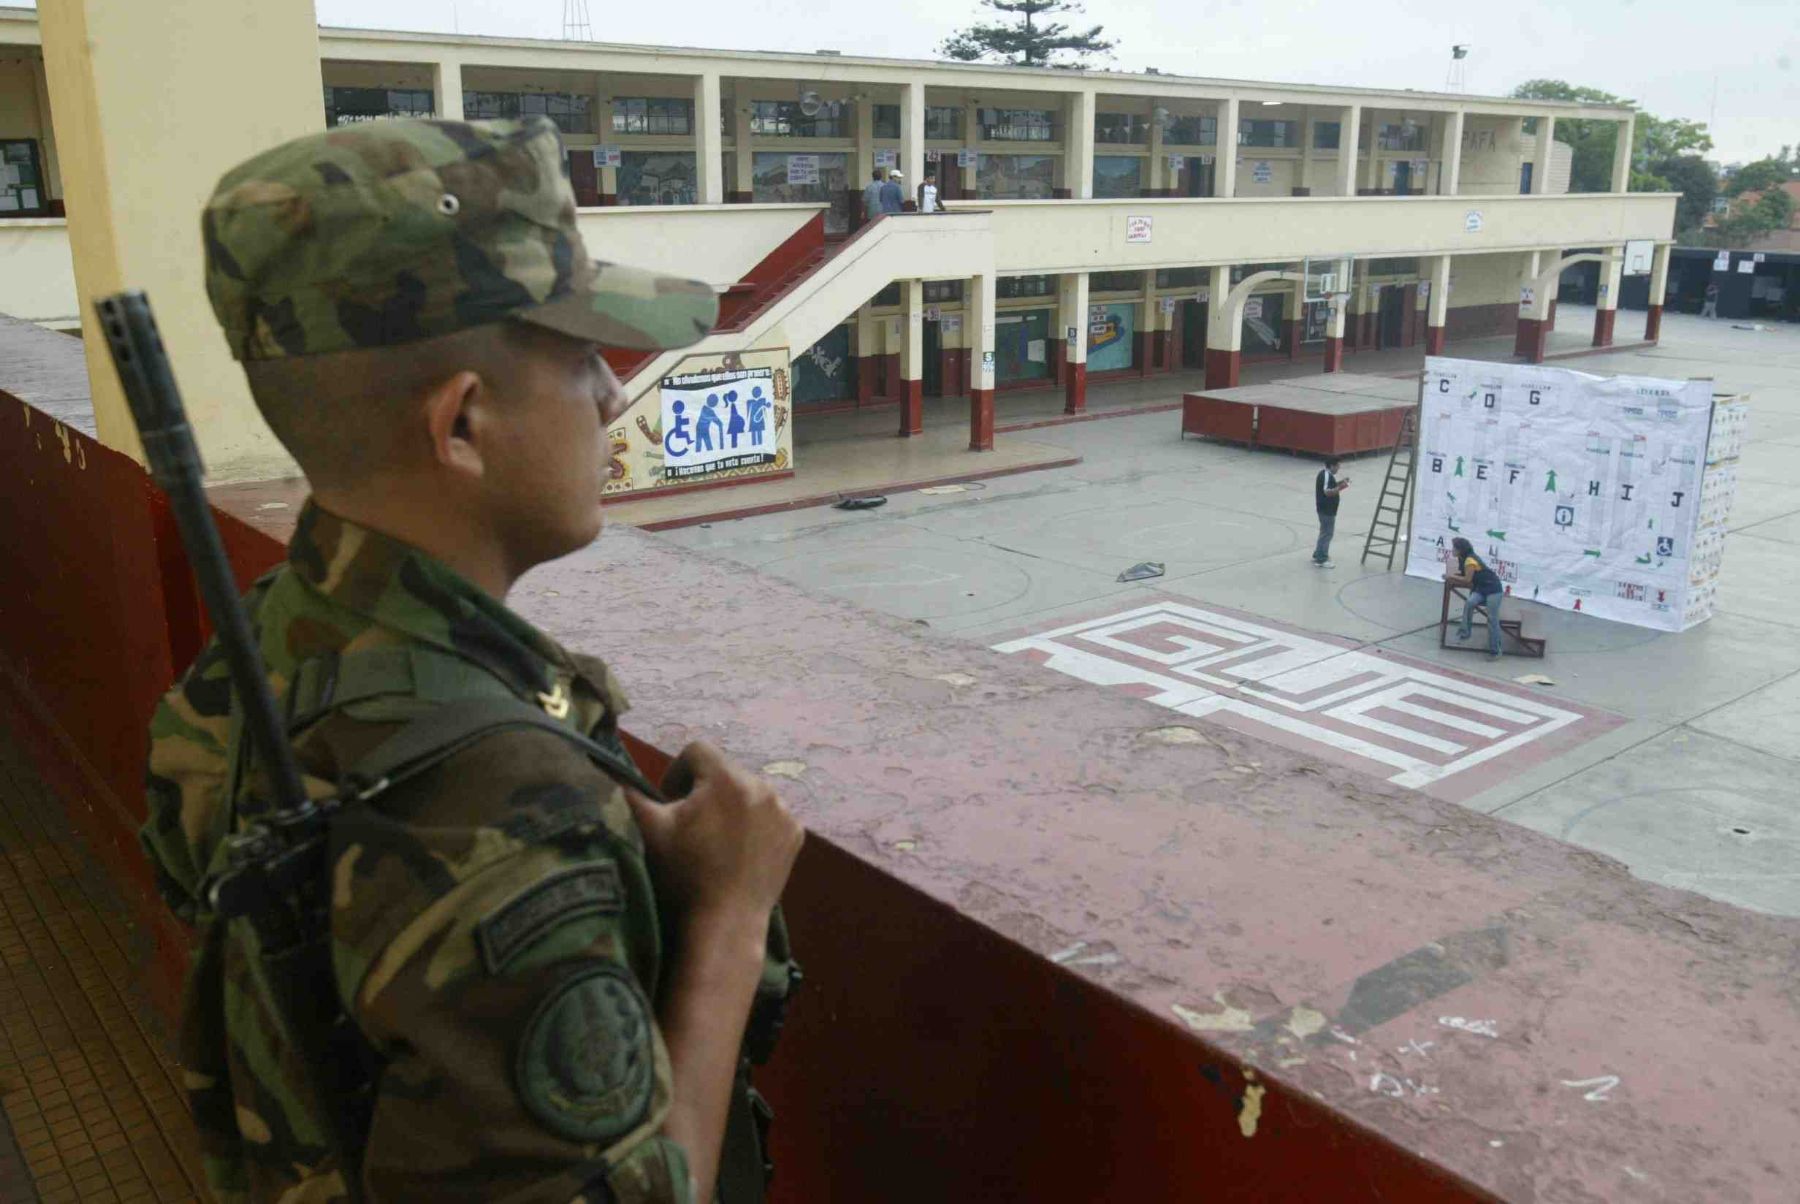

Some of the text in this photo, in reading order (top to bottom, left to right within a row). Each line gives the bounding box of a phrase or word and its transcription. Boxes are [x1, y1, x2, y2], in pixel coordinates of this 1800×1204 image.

[1439, 378, 1450, 393] C
[1484, 393, 1495, 408] D
[1529, 390, 1541, 405] G
[1432, 458, 1443, 473] B
[1476, 464, 1488, 480] E
[1509, 470, 1520, 485] F
[1588, 480, 1600, 496] H
[1620, 484, 1634, 501] I
[1671, 491, 1684, 507] J
[1436, 536, 1444, 548] A
